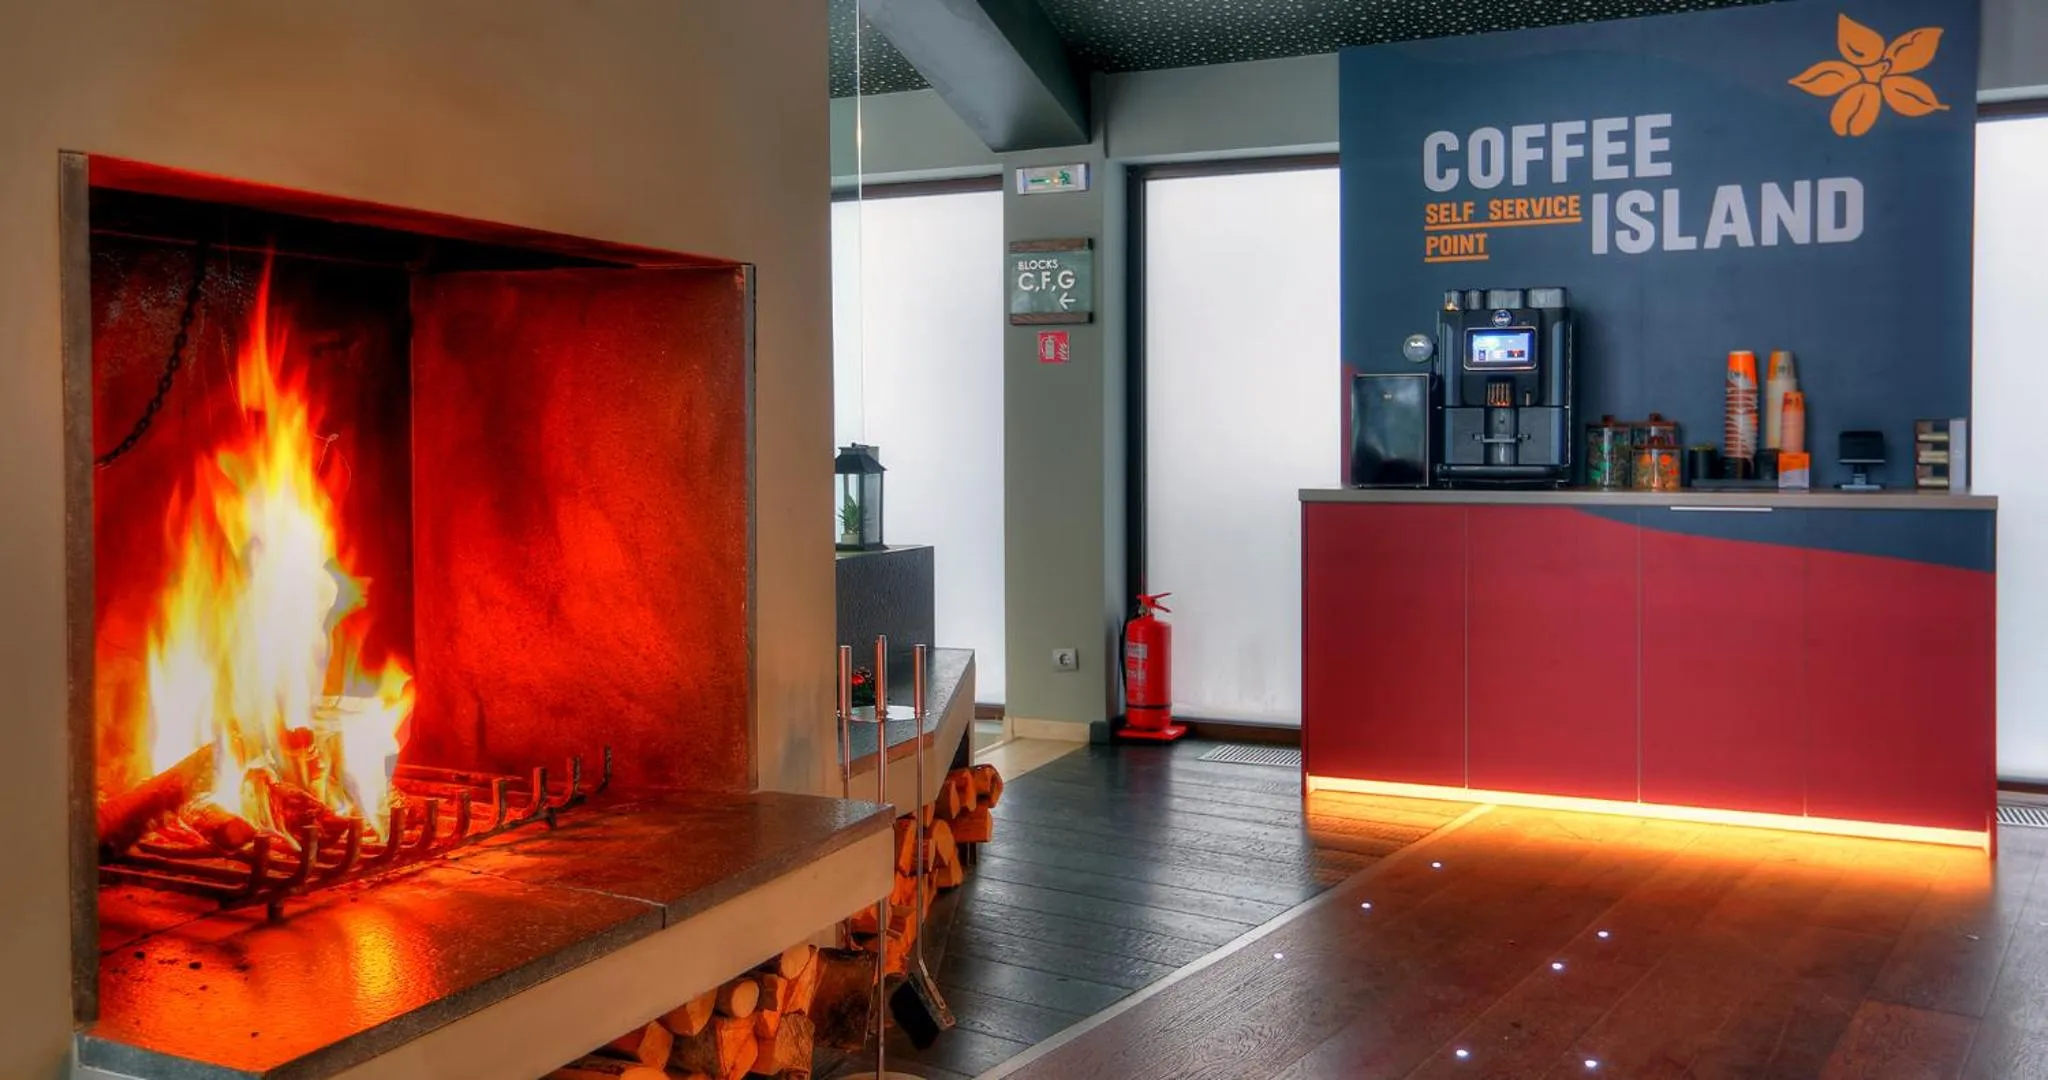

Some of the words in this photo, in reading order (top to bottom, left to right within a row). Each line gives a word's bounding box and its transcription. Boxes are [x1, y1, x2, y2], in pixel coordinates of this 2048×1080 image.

[1423, 113, 1672, 192] COFFEE
[1425, 202, 1475, 225] SELF
[1489, 195, 1581, 221] SERVICE
[1592, 177, 1865, 255] ISLAND
[1425, 233, 1487, 256] POINT
[1017, 259, 1059, 271] BLOCKS
[1018, 270, 1076, 292] C,F,G
